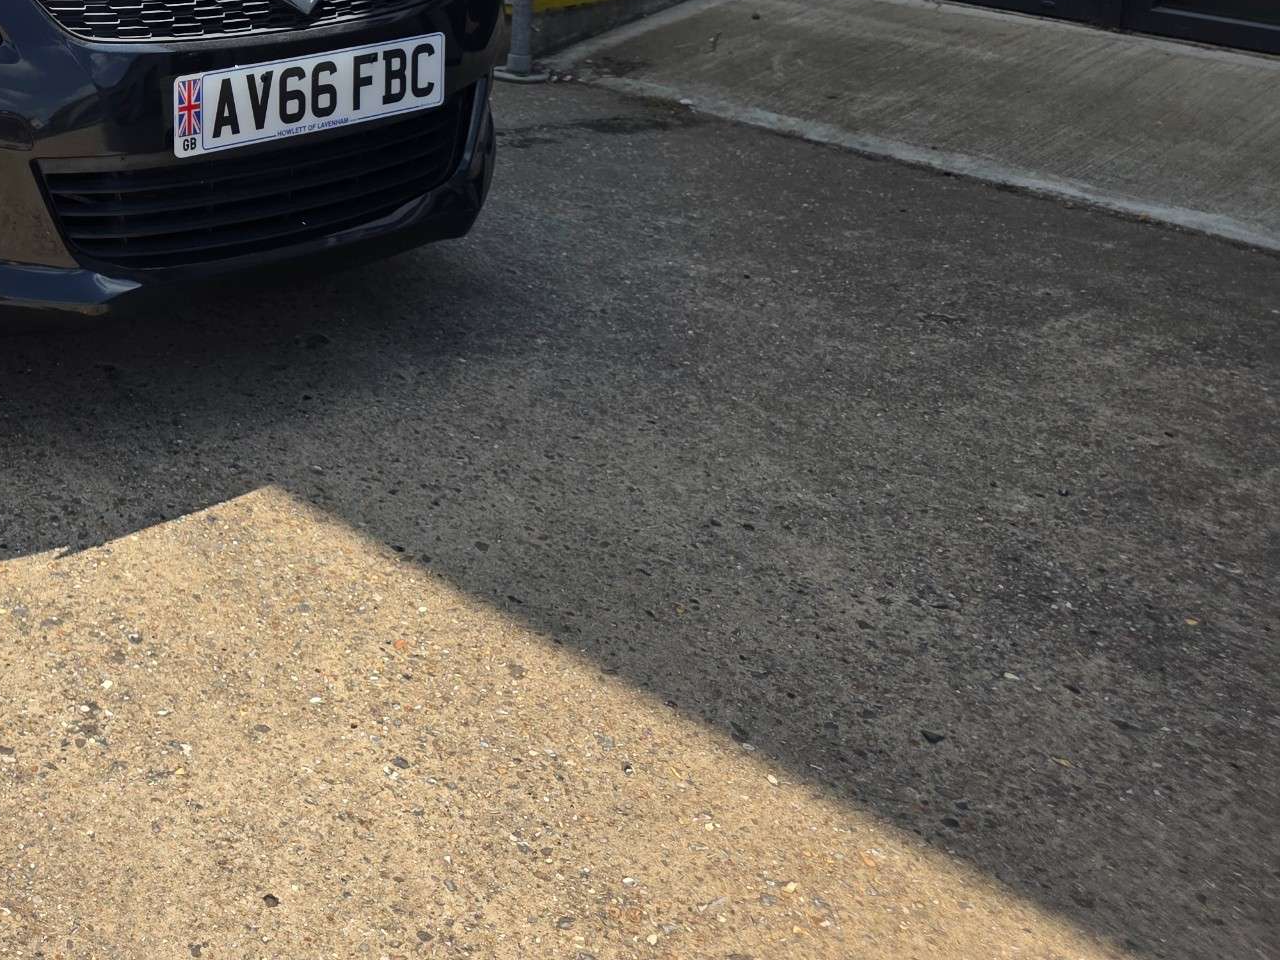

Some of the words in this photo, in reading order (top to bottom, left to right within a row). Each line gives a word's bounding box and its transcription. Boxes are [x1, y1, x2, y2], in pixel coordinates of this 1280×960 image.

[211, 60, 338, 139] AV66
[352, 42, 436, 111] FBC
[182, 137, 197, 152] GB
